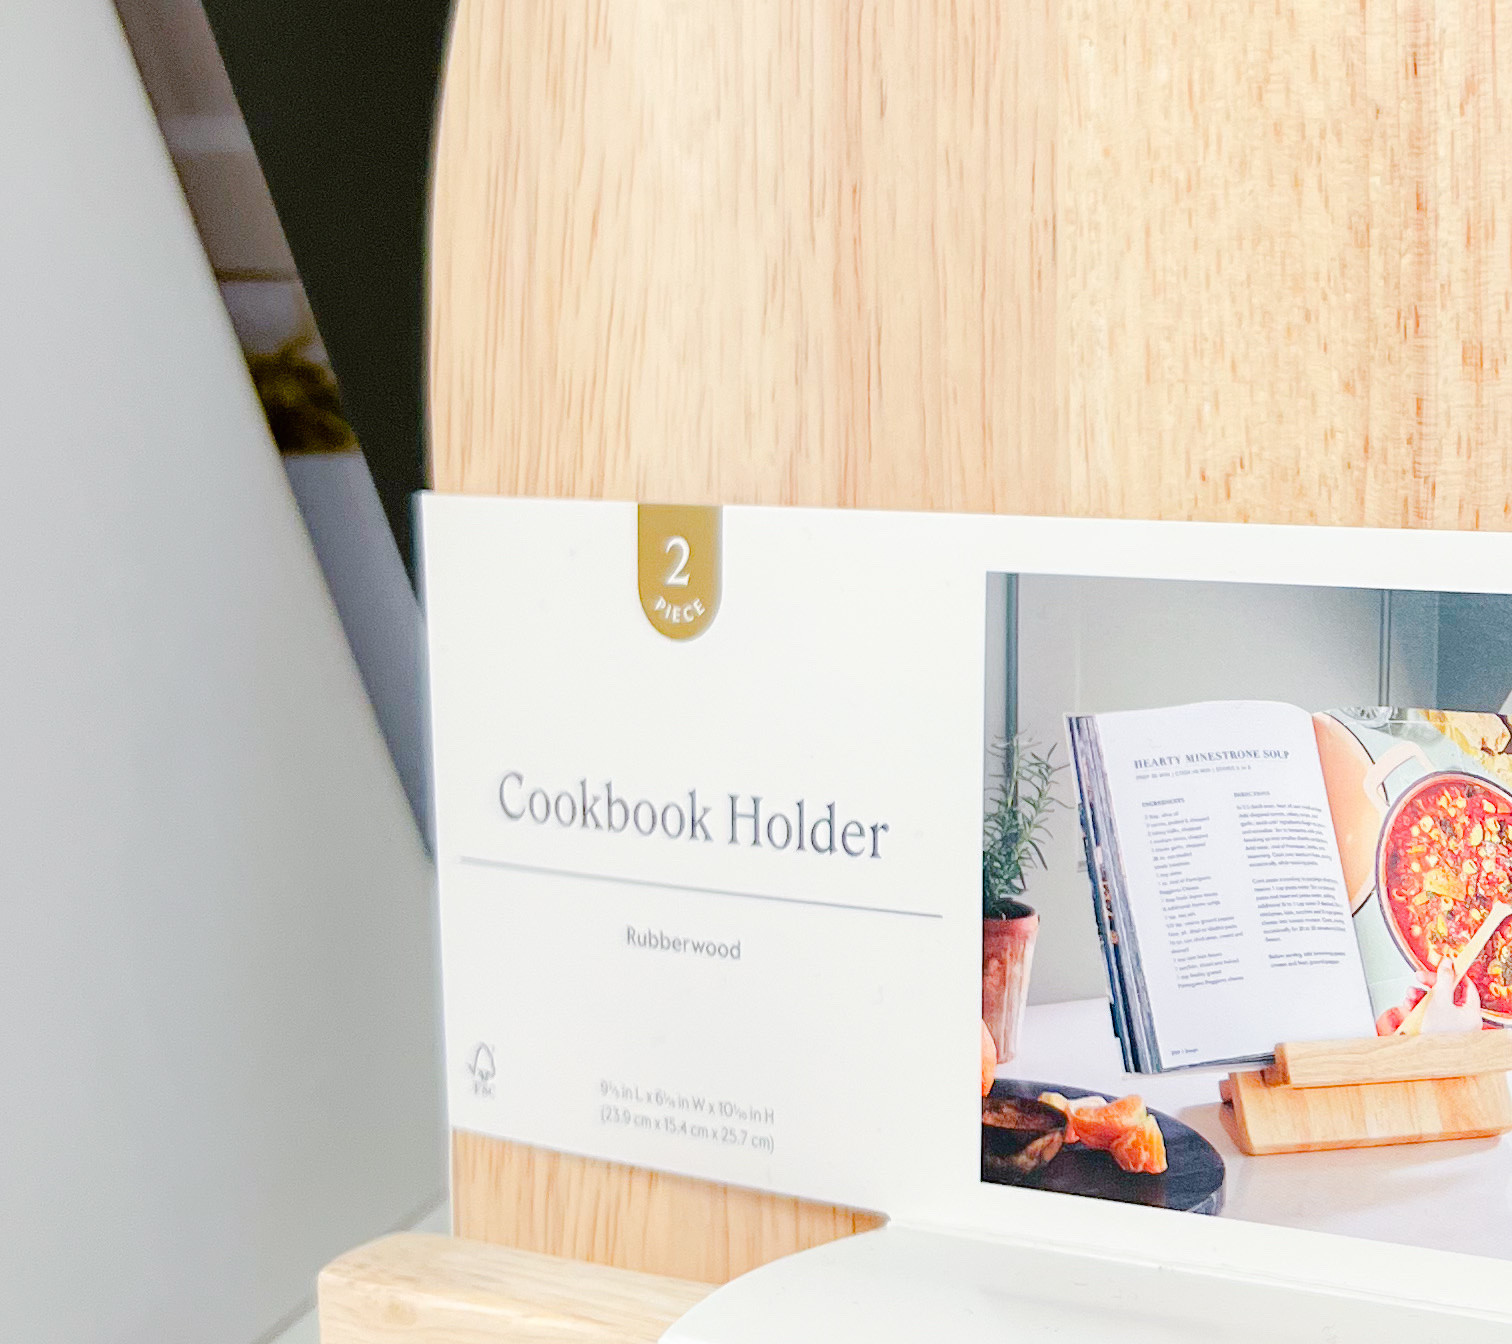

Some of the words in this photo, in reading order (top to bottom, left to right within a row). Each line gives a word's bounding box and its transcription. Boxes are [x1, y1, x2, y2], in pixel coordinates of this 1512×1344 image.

[664, 536, 690, 587] 2
[654, 596, 706, 623] PIECE
[1134, 755, 1181, 769] HEARTY
[1186, 749, 1261, 764] MINESTRONE
[498, 770, 714, 842] Cookbook
[728, 792, 890, 859] Holder
[626, 925, 742, 959] Rubberwood
[692, 1095, 706, 1112] W
[764, 1107, 775, 1124] H
[633, 1113, 652, 1128] cm
[690, 1123, 709, 1138] cm
[721, 1127, 748, 1146] 25.7
[751, 1135, 775, 1154] cm)
